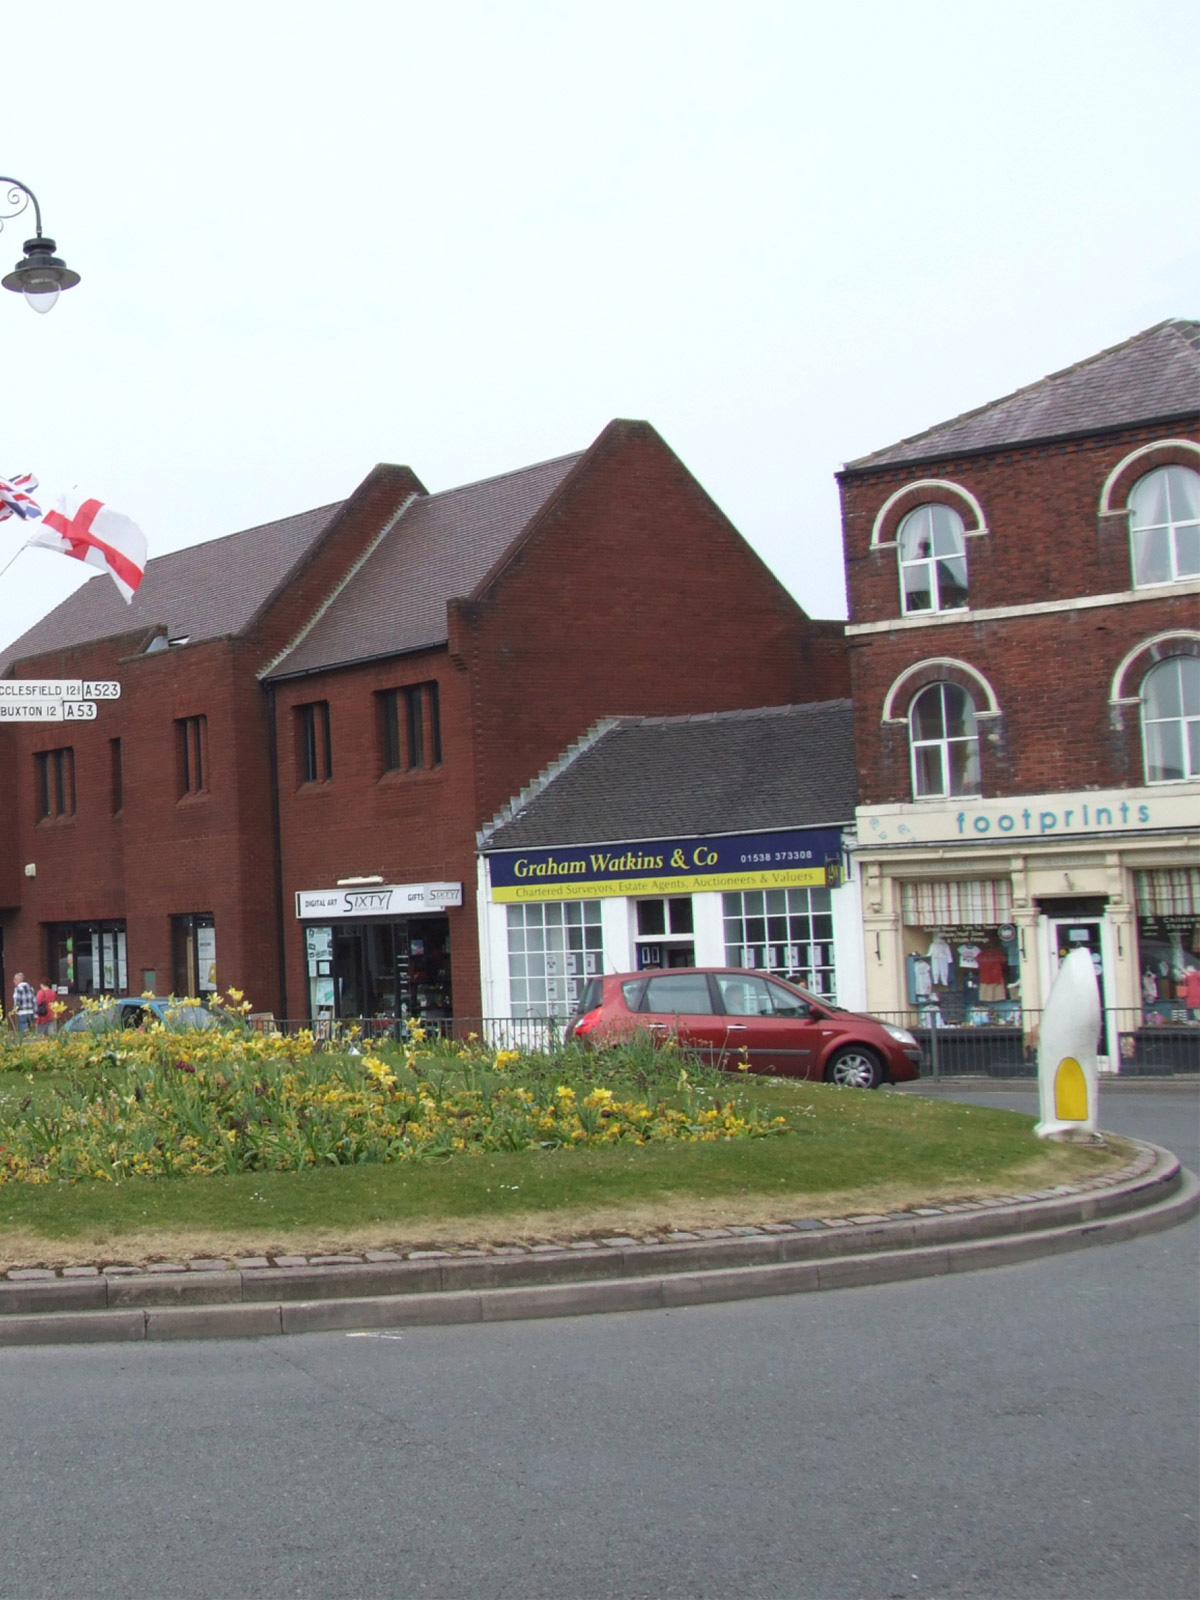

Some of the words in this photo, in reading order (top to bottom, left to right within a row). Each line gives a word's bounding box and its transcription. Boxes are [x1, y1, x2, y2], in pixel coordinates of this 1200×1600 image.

[0, 706, 43, 716] BUXTON
[46, 706, 57, 716] 12
[956, 801, 1150, 833] footprints
[513, 856, 587, 878] Graham
[589, 851, 664, 873] Watkins
[669, 848, 690, 870] &
[693, 846, 718, 866] Co
[740, 853, 771, 863] 01538
[774, 850, 813, 861] 373308
[515, 885, 563, 898] Chartered
[566, 884, 616, 897] Surveyors,
[619, 881, 648, 892] Estate
[652, 879, 689, 892] Agents,
[692, 875, 756, 887] Auctioneers
[759, 874, 768, 883] &
[771, 871, 814, 882] Valuers
[304, 899, 326, 908] DIGITAL
[327, 898, 338, 906] ART
[407, 892, 424, 902] GIFTS
